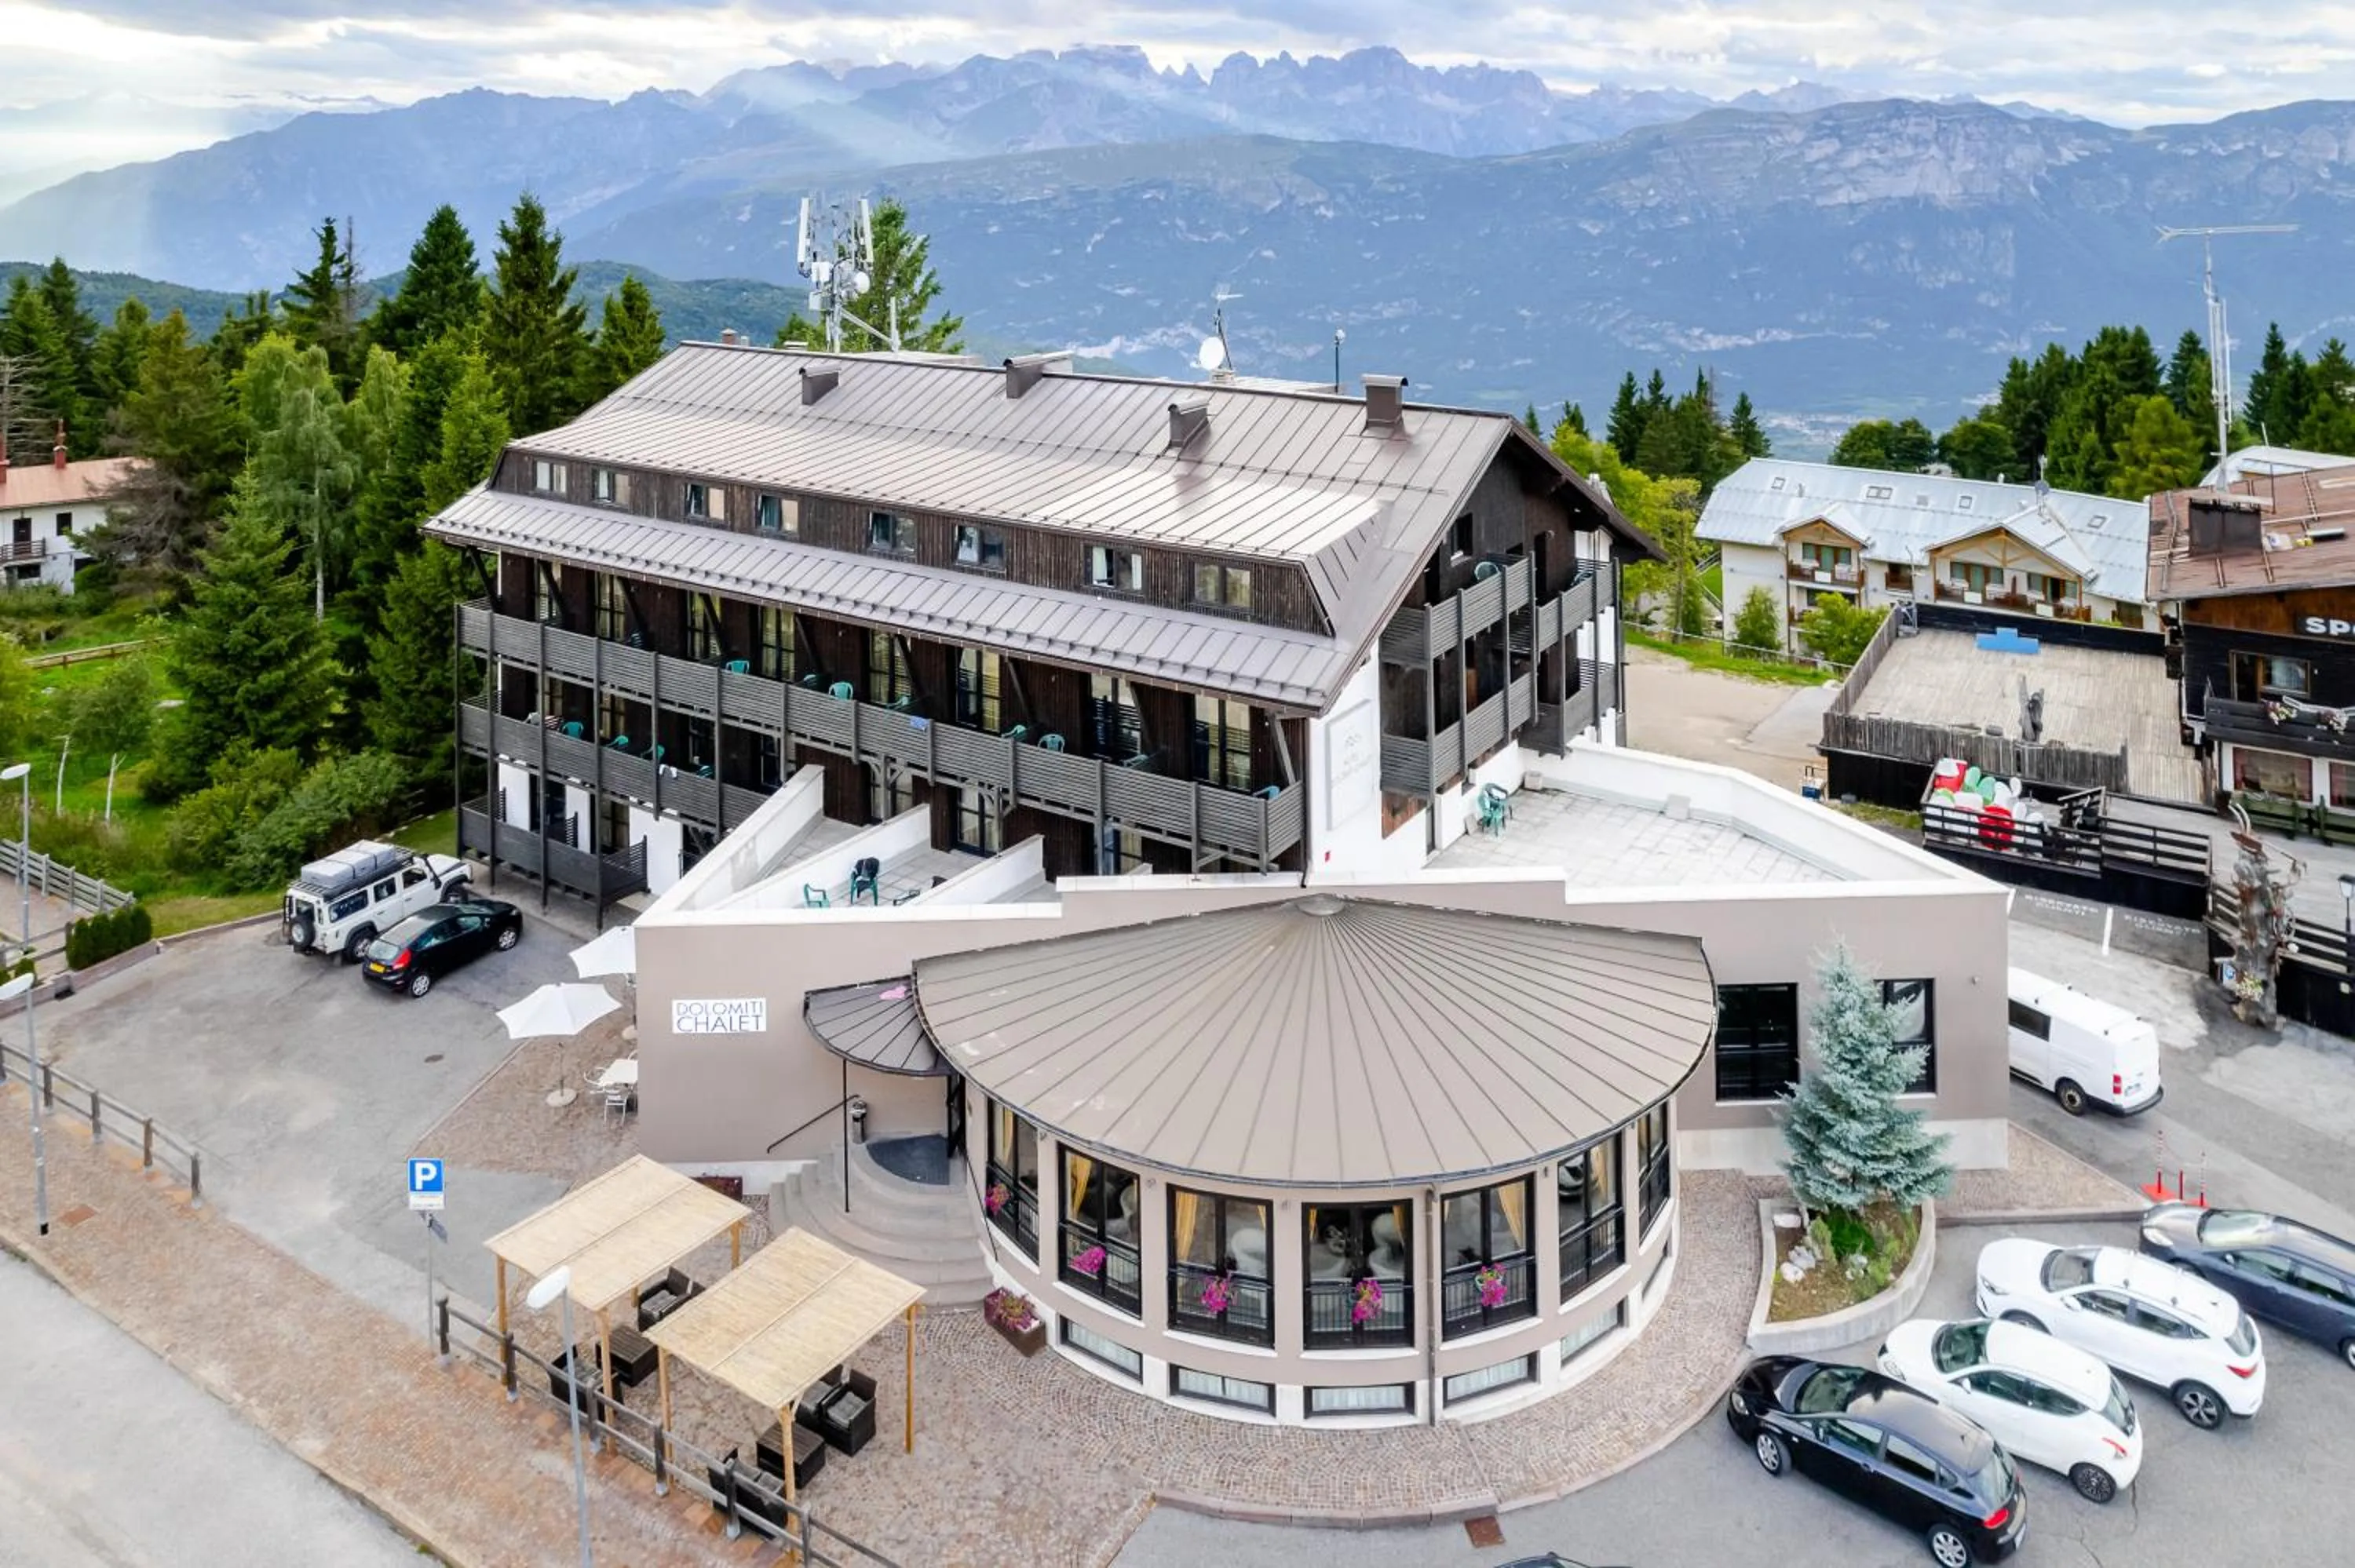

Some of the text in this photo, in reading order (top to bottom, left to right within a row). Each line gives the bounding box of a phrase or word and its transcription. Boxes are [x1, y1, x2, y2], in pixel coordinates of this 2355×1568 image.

[2306, 617, 2355, 636] SP
[676, 1001, 763, 1016] DOLOMITI
[676, 1015, 763, 1032] CHALET
[414, 1161, 437, 1191] P
